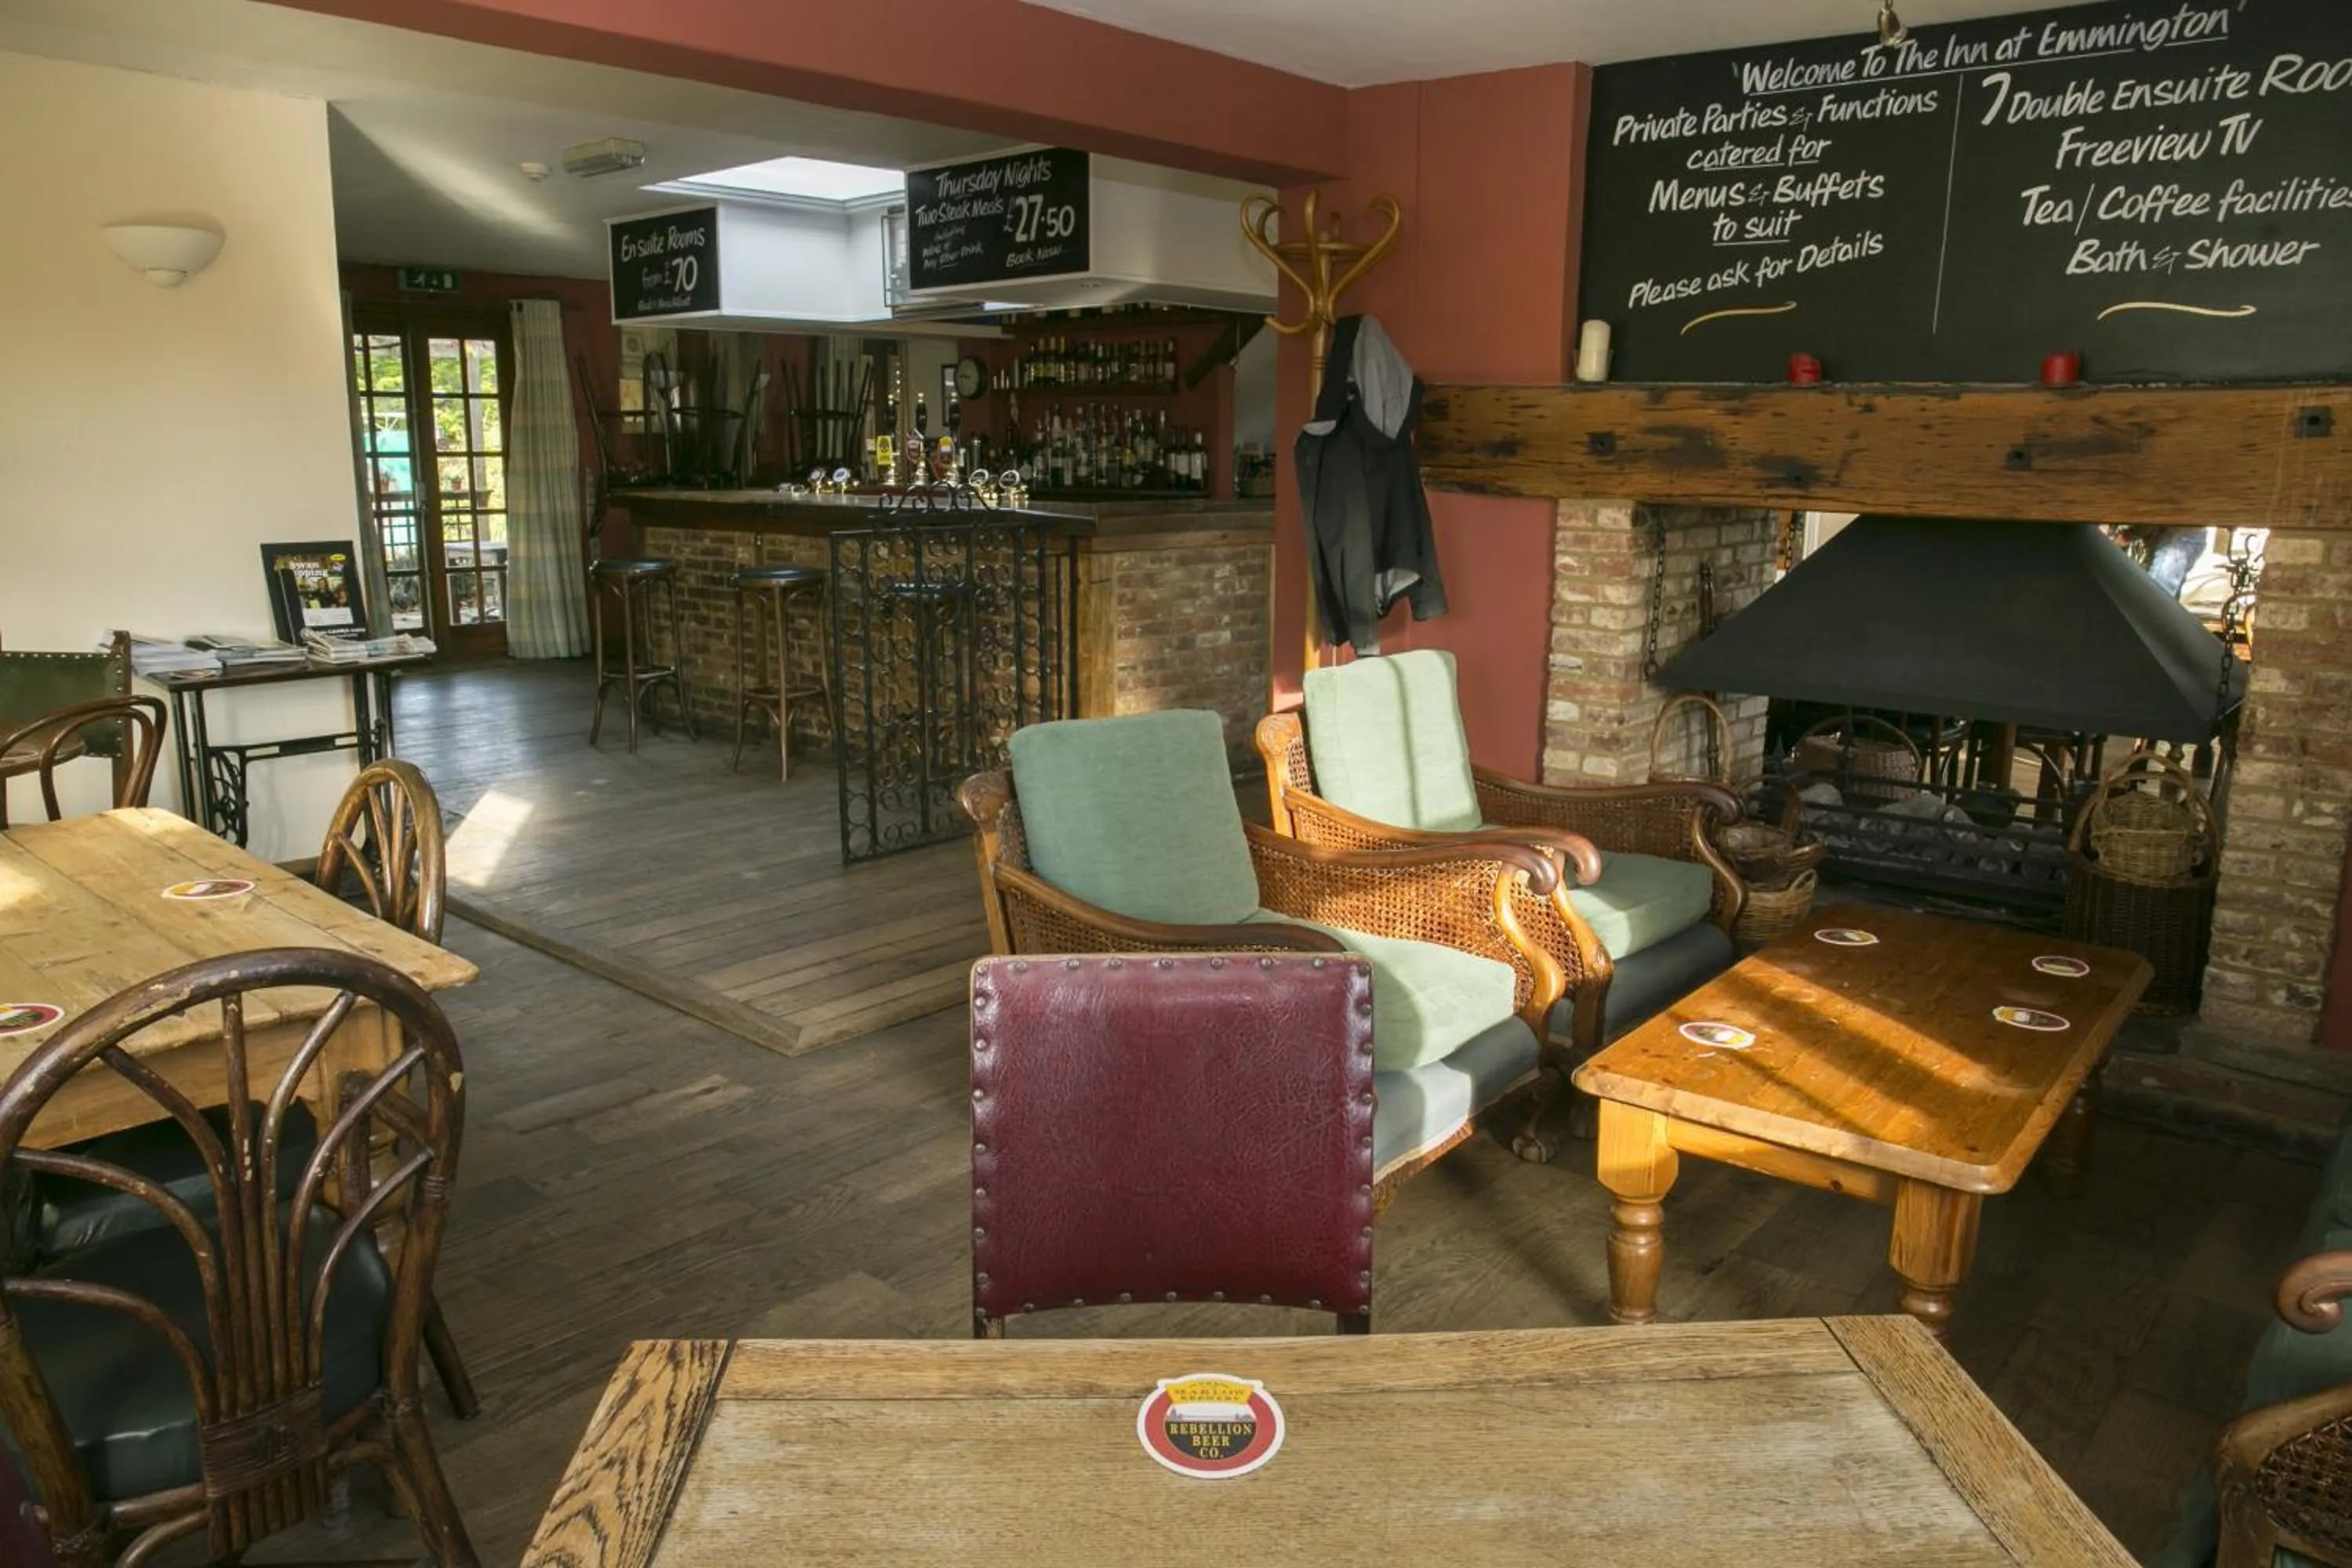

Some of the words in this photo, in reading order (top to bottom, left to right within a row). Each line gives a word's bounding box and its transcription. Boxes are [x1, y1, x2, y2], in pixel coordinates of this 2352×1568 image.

[1860, 42, 1886, 78] To
[1893, 38, 1939, 74] The
[1944, 34, 1989, 67] Inn
[1994, 26, 2033, 61] at
[1980, 71, 2012, 125] 7
[2007, 78, 2104, 124] Double
[2111, 63, 2252, 111] Ensuite
[2259, 53, 2352, 97] Roo
[1612, 106, 1698, 146] Private
[1700, 100, 1788, 134] Parties
[1817, 88, 1939, 124] Functions
[1686, 133, 1785, 170] catered
[1788, 135, 1832, 166] for
[2055, 124, 2212, 169] Freeview
[2218, 112, 2264, 156] TV
[935, 165, 1003, 198] Thursday
[1004, 155, 1052, 188] Nights
[1648, 179, 1747, 214] Menus
[1772, 169, 1886, 207] Buffets
[2096, 183, 2212, 223] Coffee
[667, 225, 706, 252] Rooms
[1712, 212, 1737, 242] to
[1744, 209, 1802, 239] suit
[1628, 276, 1703, 309] Please
[1706, 260, 1751, 292] ask
[1755, 255, 1794, 288] for
[1795, 230, 1885, 273] Details
[2066, 238, 2148, 275] Bath
[2184, 238, 2321, 270] Shower
[1171, 1423, 1253, 1435] REBELLION
[1192, 1436, 1230, 1446] BEER
[1200, 1447, 1224, 1458] CO.
